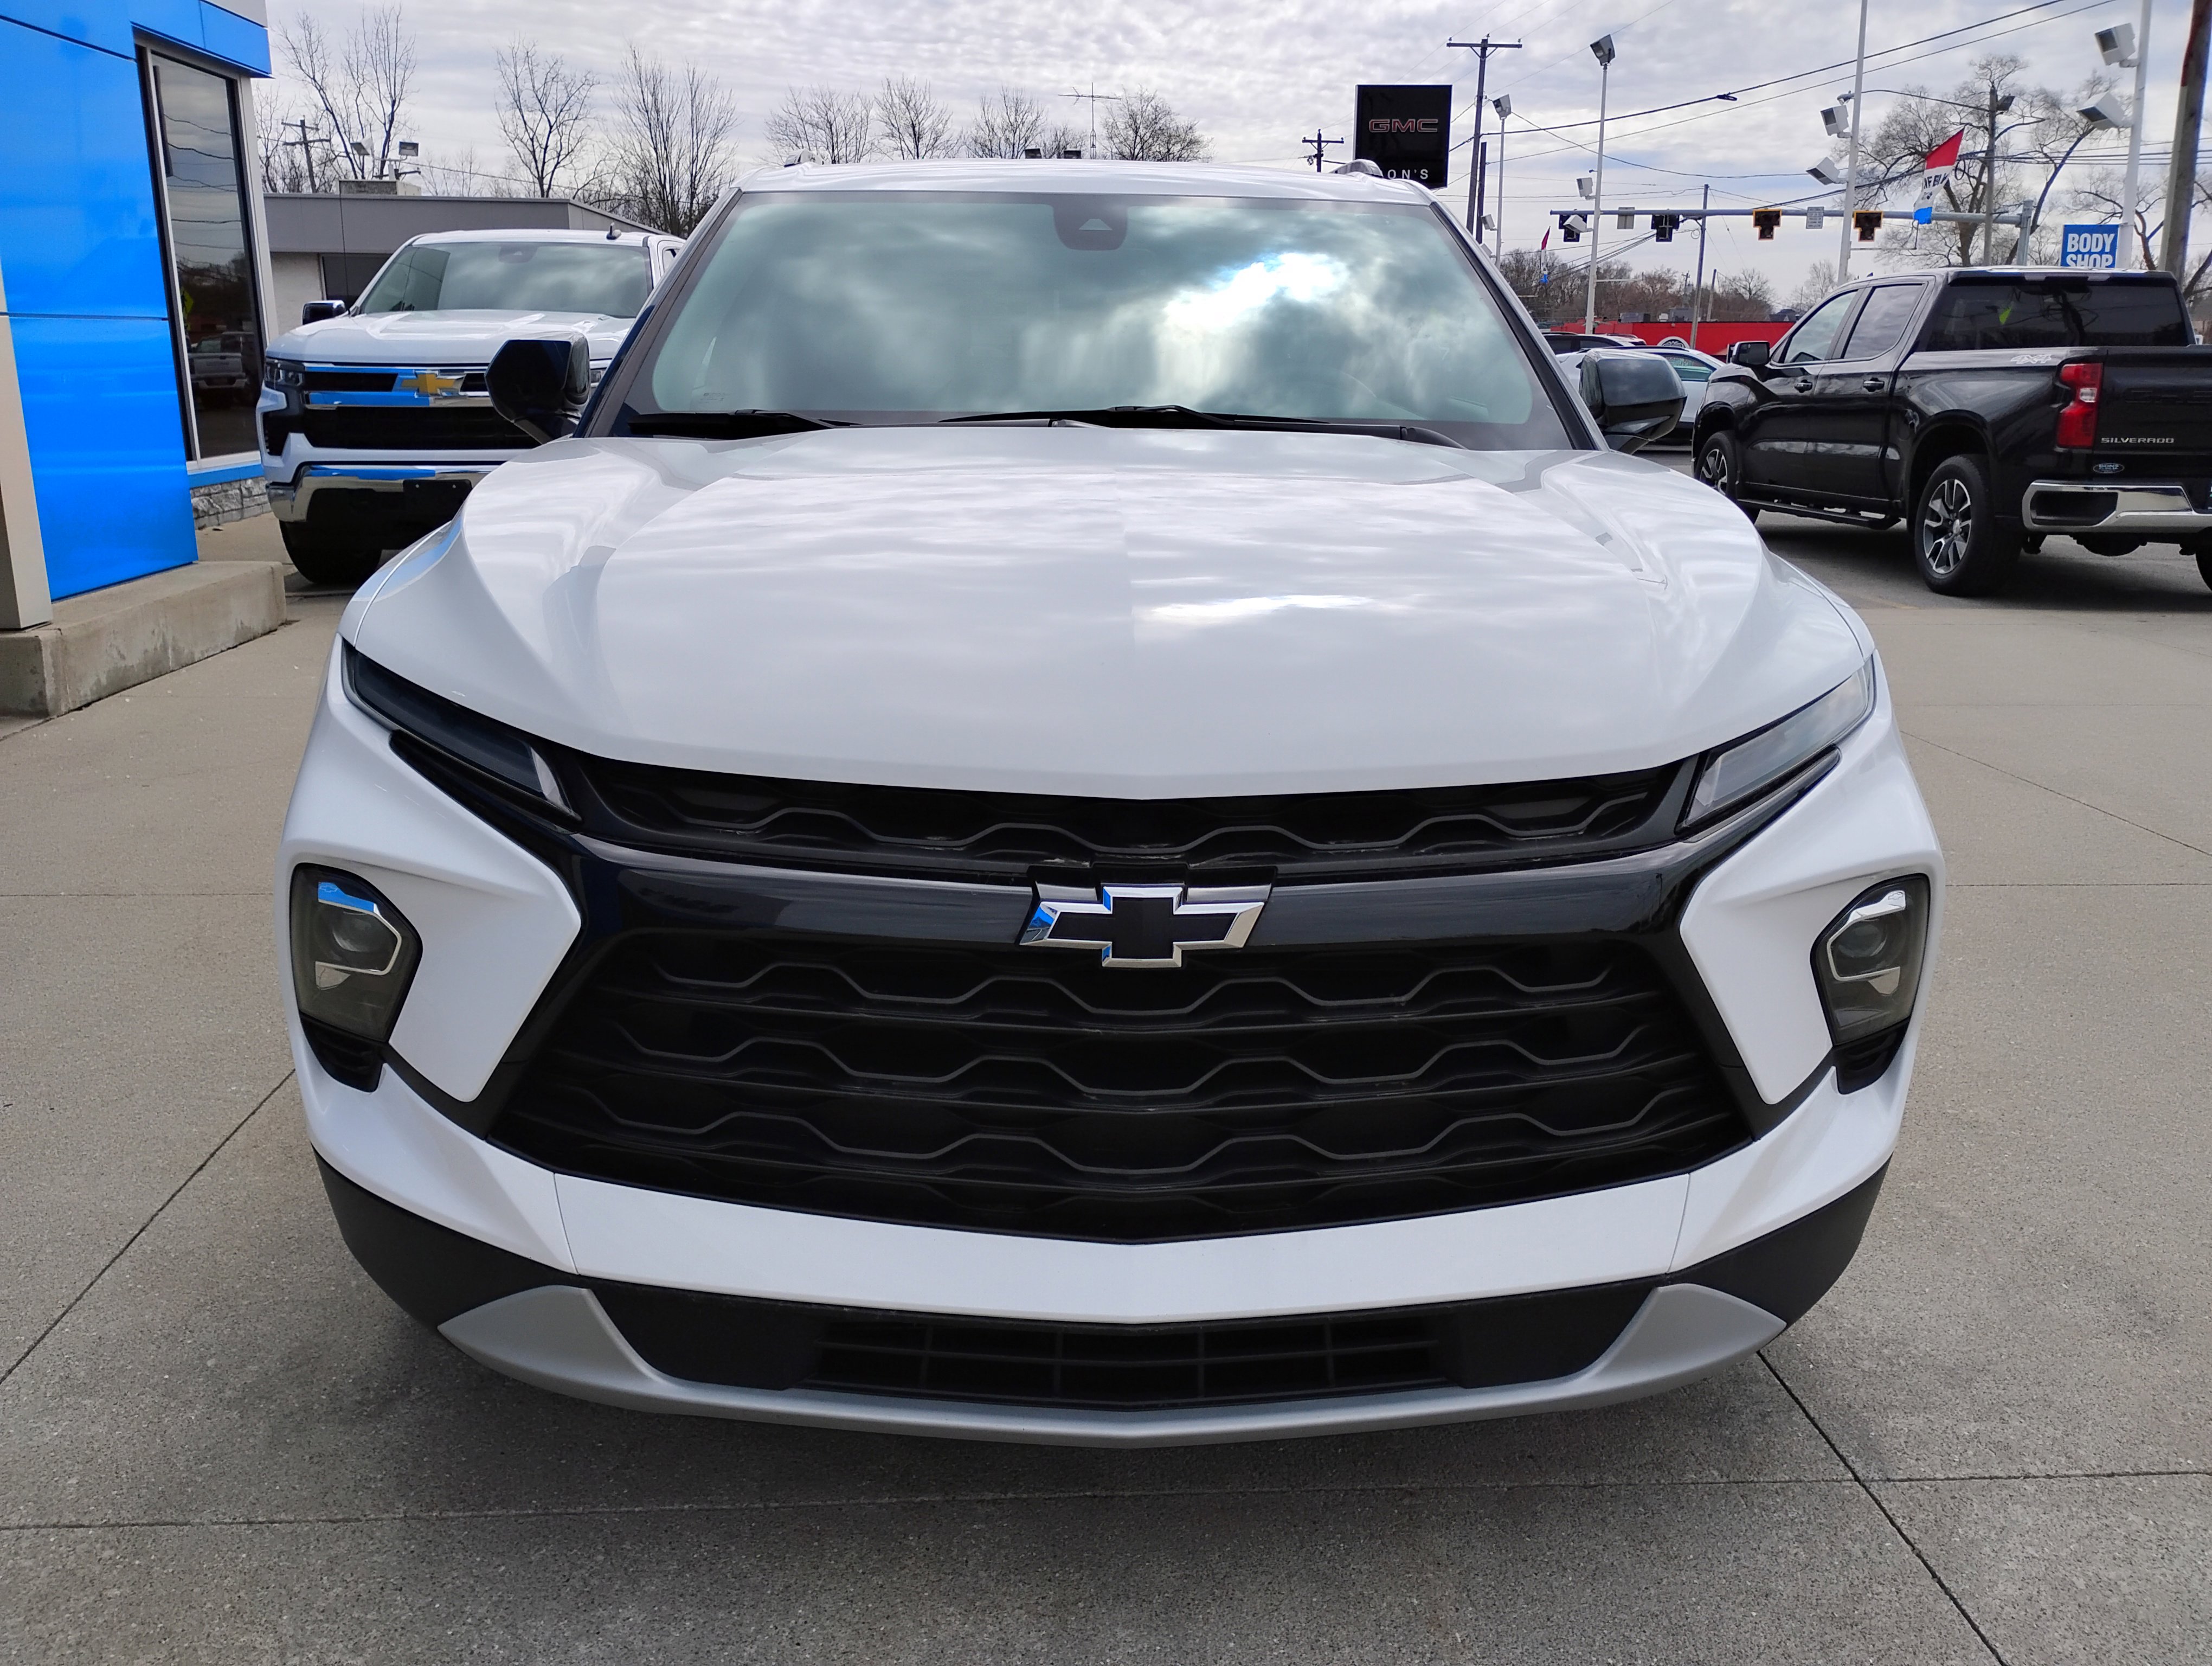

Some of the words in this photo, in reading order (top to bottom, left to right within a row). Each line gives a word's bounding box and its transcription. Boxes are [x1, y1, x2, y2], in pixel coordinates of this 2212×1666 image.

[1369, 119, 1438, 133] GMC
[1387, 169, 1429, 180] ON'S
[2067, 233, 2115, 252] BODY
[2066, 254, 2113, 267] SHOP
